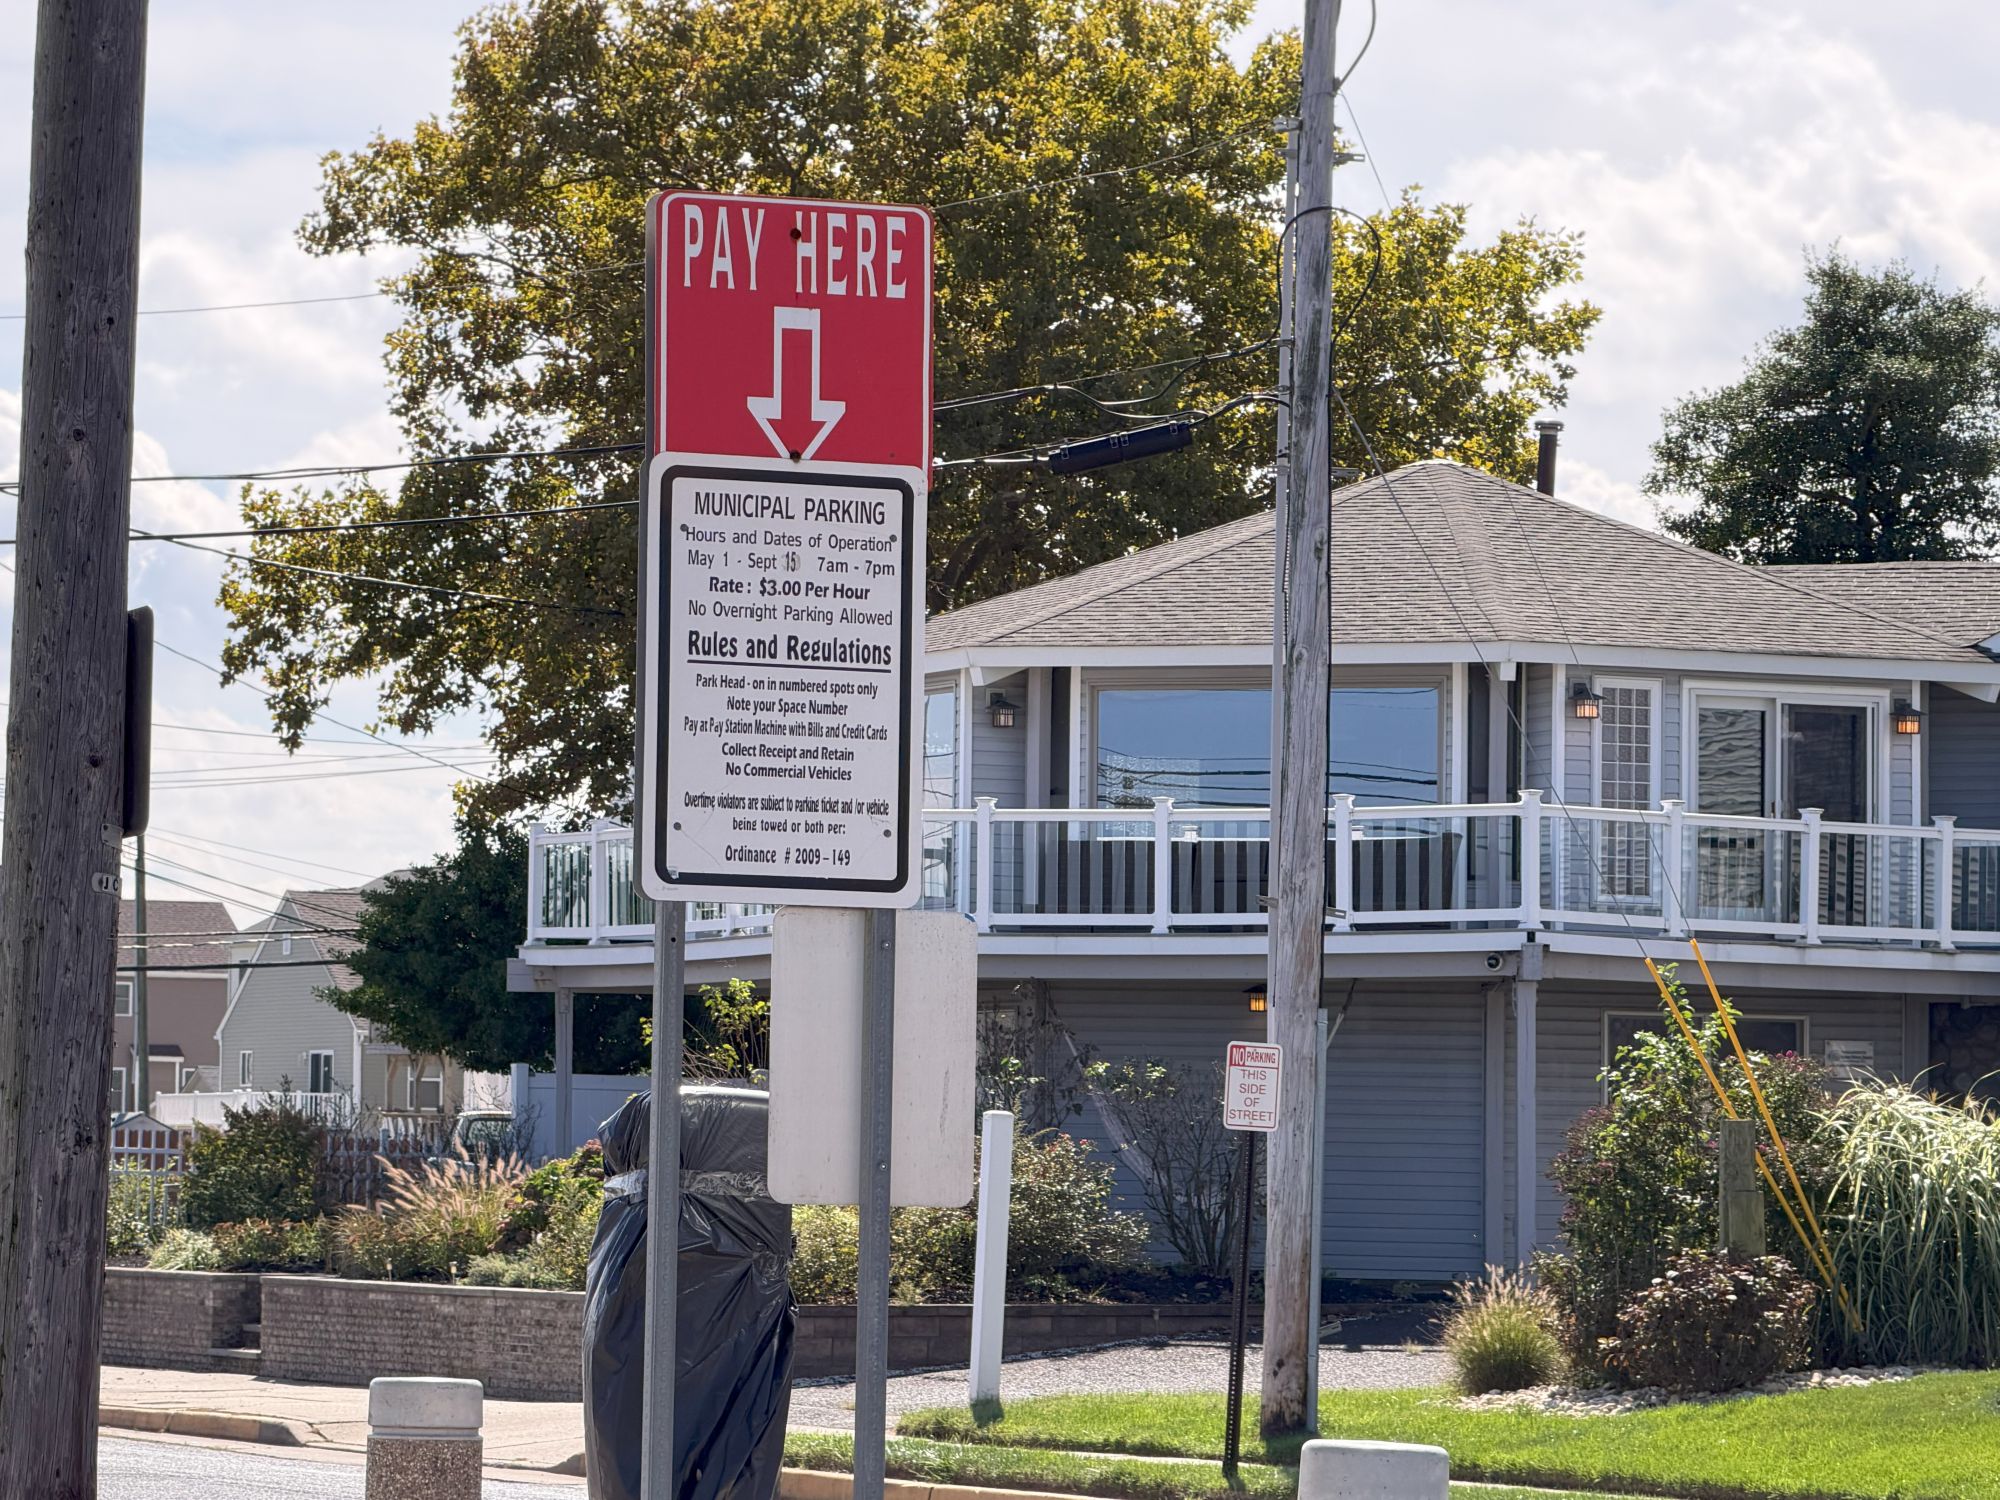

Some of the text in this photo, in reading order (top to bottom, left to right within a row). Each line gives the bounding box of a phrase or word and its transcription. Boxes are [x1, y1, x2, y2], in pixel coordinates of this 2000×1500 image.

[684, 204, 906, 298] PAY HERE
[695, 492, 885, 525] MUNICIPAL PARKING
[686, 526, 892, 552] Hours and Dates of Operation
[688, 549, 714, 569] May
[724, 552, 727, 566] 1
[748, 553, 777, 572] Sept
[818, 557, 848, 573] 7am
[866, 560, 894, 578] 7pm
[760, 577, 801, 596] $3.00
[805, 582, 829, 597] Per
[833, 583, 870, 600] Hour
[689, 600, 892, 625] No Overnight Parking Allowed
[689, 630, 891, 665] Rules and Regulations
[696, 674, 717, 687] Park
[720, 675, 745, 688] Head
[753, 680, 764, 690] on
[768, 677, 776, 690] in
[779, 679, 827, 693] numbered
[830, 682, 854, 697] spots
[857, 682, 878, 699] only
[727, 696, 848, 717] Note your Space Number
[684, 716, 887, 740] Pay at Pay Station Machine with Bills and Credit Cards
[722, 742, 854, 762] Collect Receipt and Retain
[726, 762, 851, 780] No Commercial Vehicles
[684, 791, 715, 809] Overtime
[717, 793, 745, 809] violators
[748, 798, 759, 810] are
[761, 795, 784, 811] subject
[786, 797, 793, 812] to
[795, 797, 819, 812] parking
[821, 798, 839, 813] ticket
[841, 799, 852, 814] and
[867, 800, 889, 816] vehicle
[733, 817, 845, 834] being towed or both per:
[726, 845, 776, 863] Ordinance
[785, 848, 790, 864] #
[1232, 1047, 1275, 1065] NO PARKING
[1241, 1070, 1267, 1080] THIS
[1240, 1084, 1267, 1094] SIDE
[1244, 1097, 1260, 1107] OF
[1229, 1109, 1274, 1121] STREET
